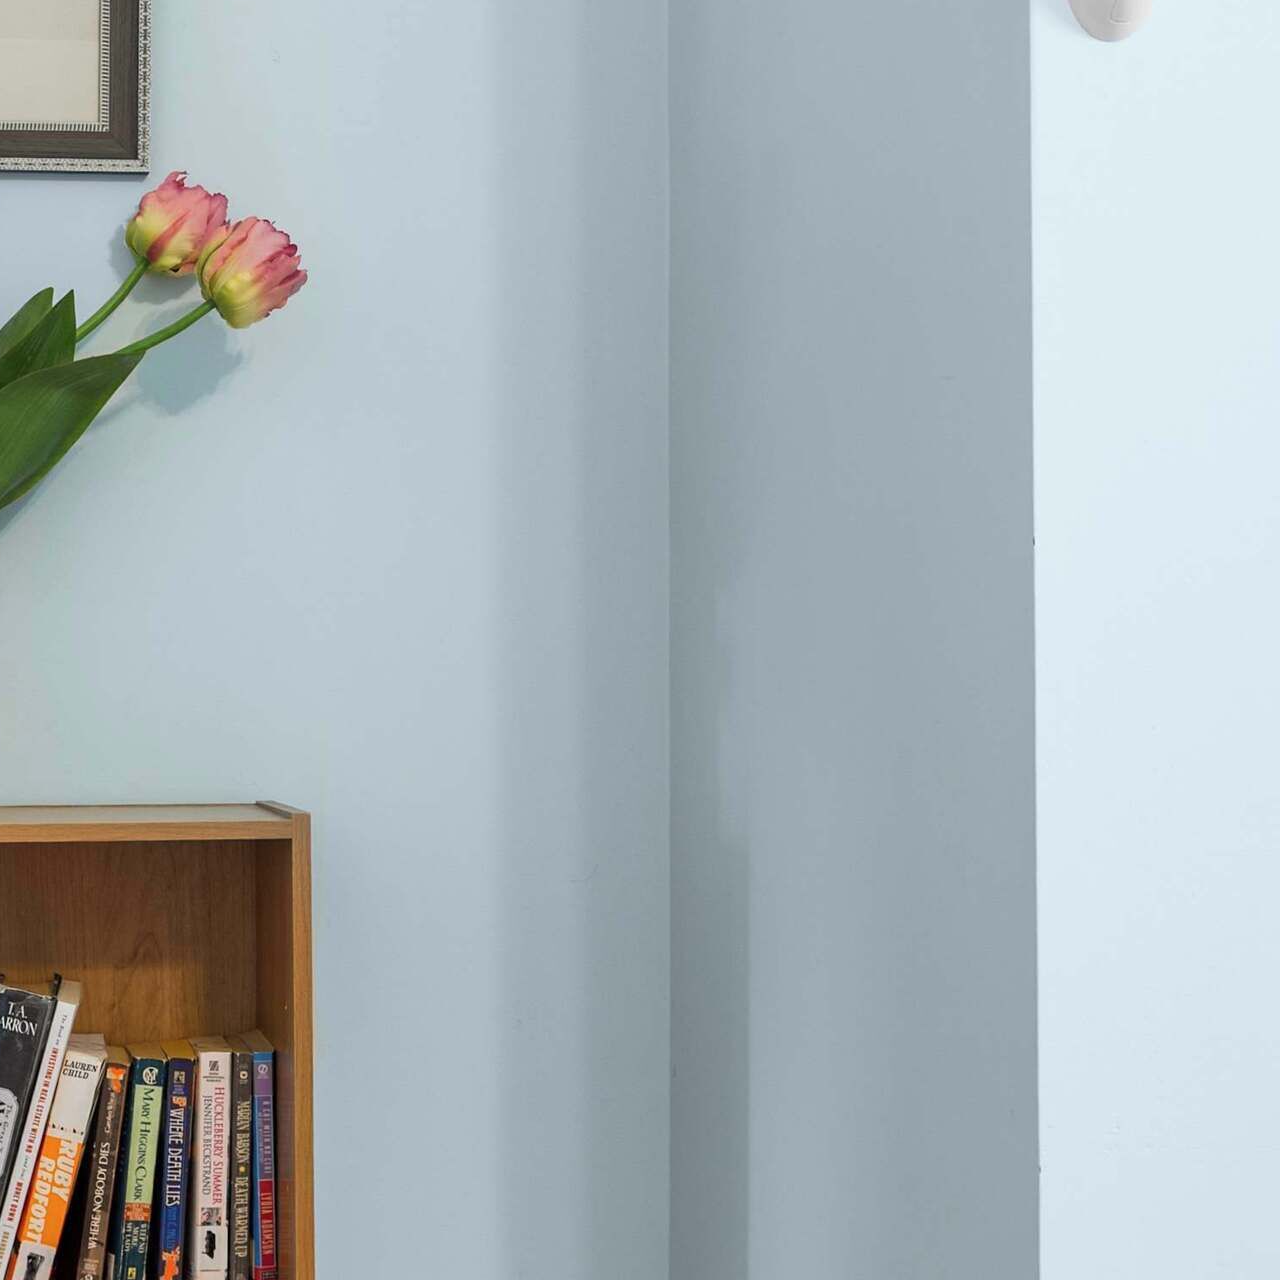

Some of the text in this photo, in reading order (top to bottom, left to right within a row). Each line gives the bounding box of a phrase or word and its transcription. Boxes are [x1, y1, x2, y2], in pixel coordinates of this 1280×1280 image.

[45, 1047, 59, 1079] INVESTING
[62, 1068, 90, 1080] CHILD
[64, 1060, 98, 1072] LAUREN
[37, 1087, 48, 1104] REAL
[140, 1087, 154, 1119] MARY
[31, 1103, 44, 1127] ESTATE
[168, 1108, 184, 1145] WHERE
[213, 1087, 225, 1157] HUCKLEBERRY
[27, 1126, 38, 1143] WITH
[136, 1120, 151, 1165] HIGGINS
[202, 1095, 213, 1195] JENNIFER BECKSTRAND
[51, 1138, 77, 1202] RUBY
[97, 1142, 111, 1165] DIES
[167, 1148, 183, 1182] DEATH
[92, 1165, 108, 1213] NOBODY
[133, 1165, 147, 1201] CLARK
[166, 1185, 180, 1207] LIES
[212, 1161, 224, 1205] SUMMER
[87, 1213, 102, 1250] WHERE
